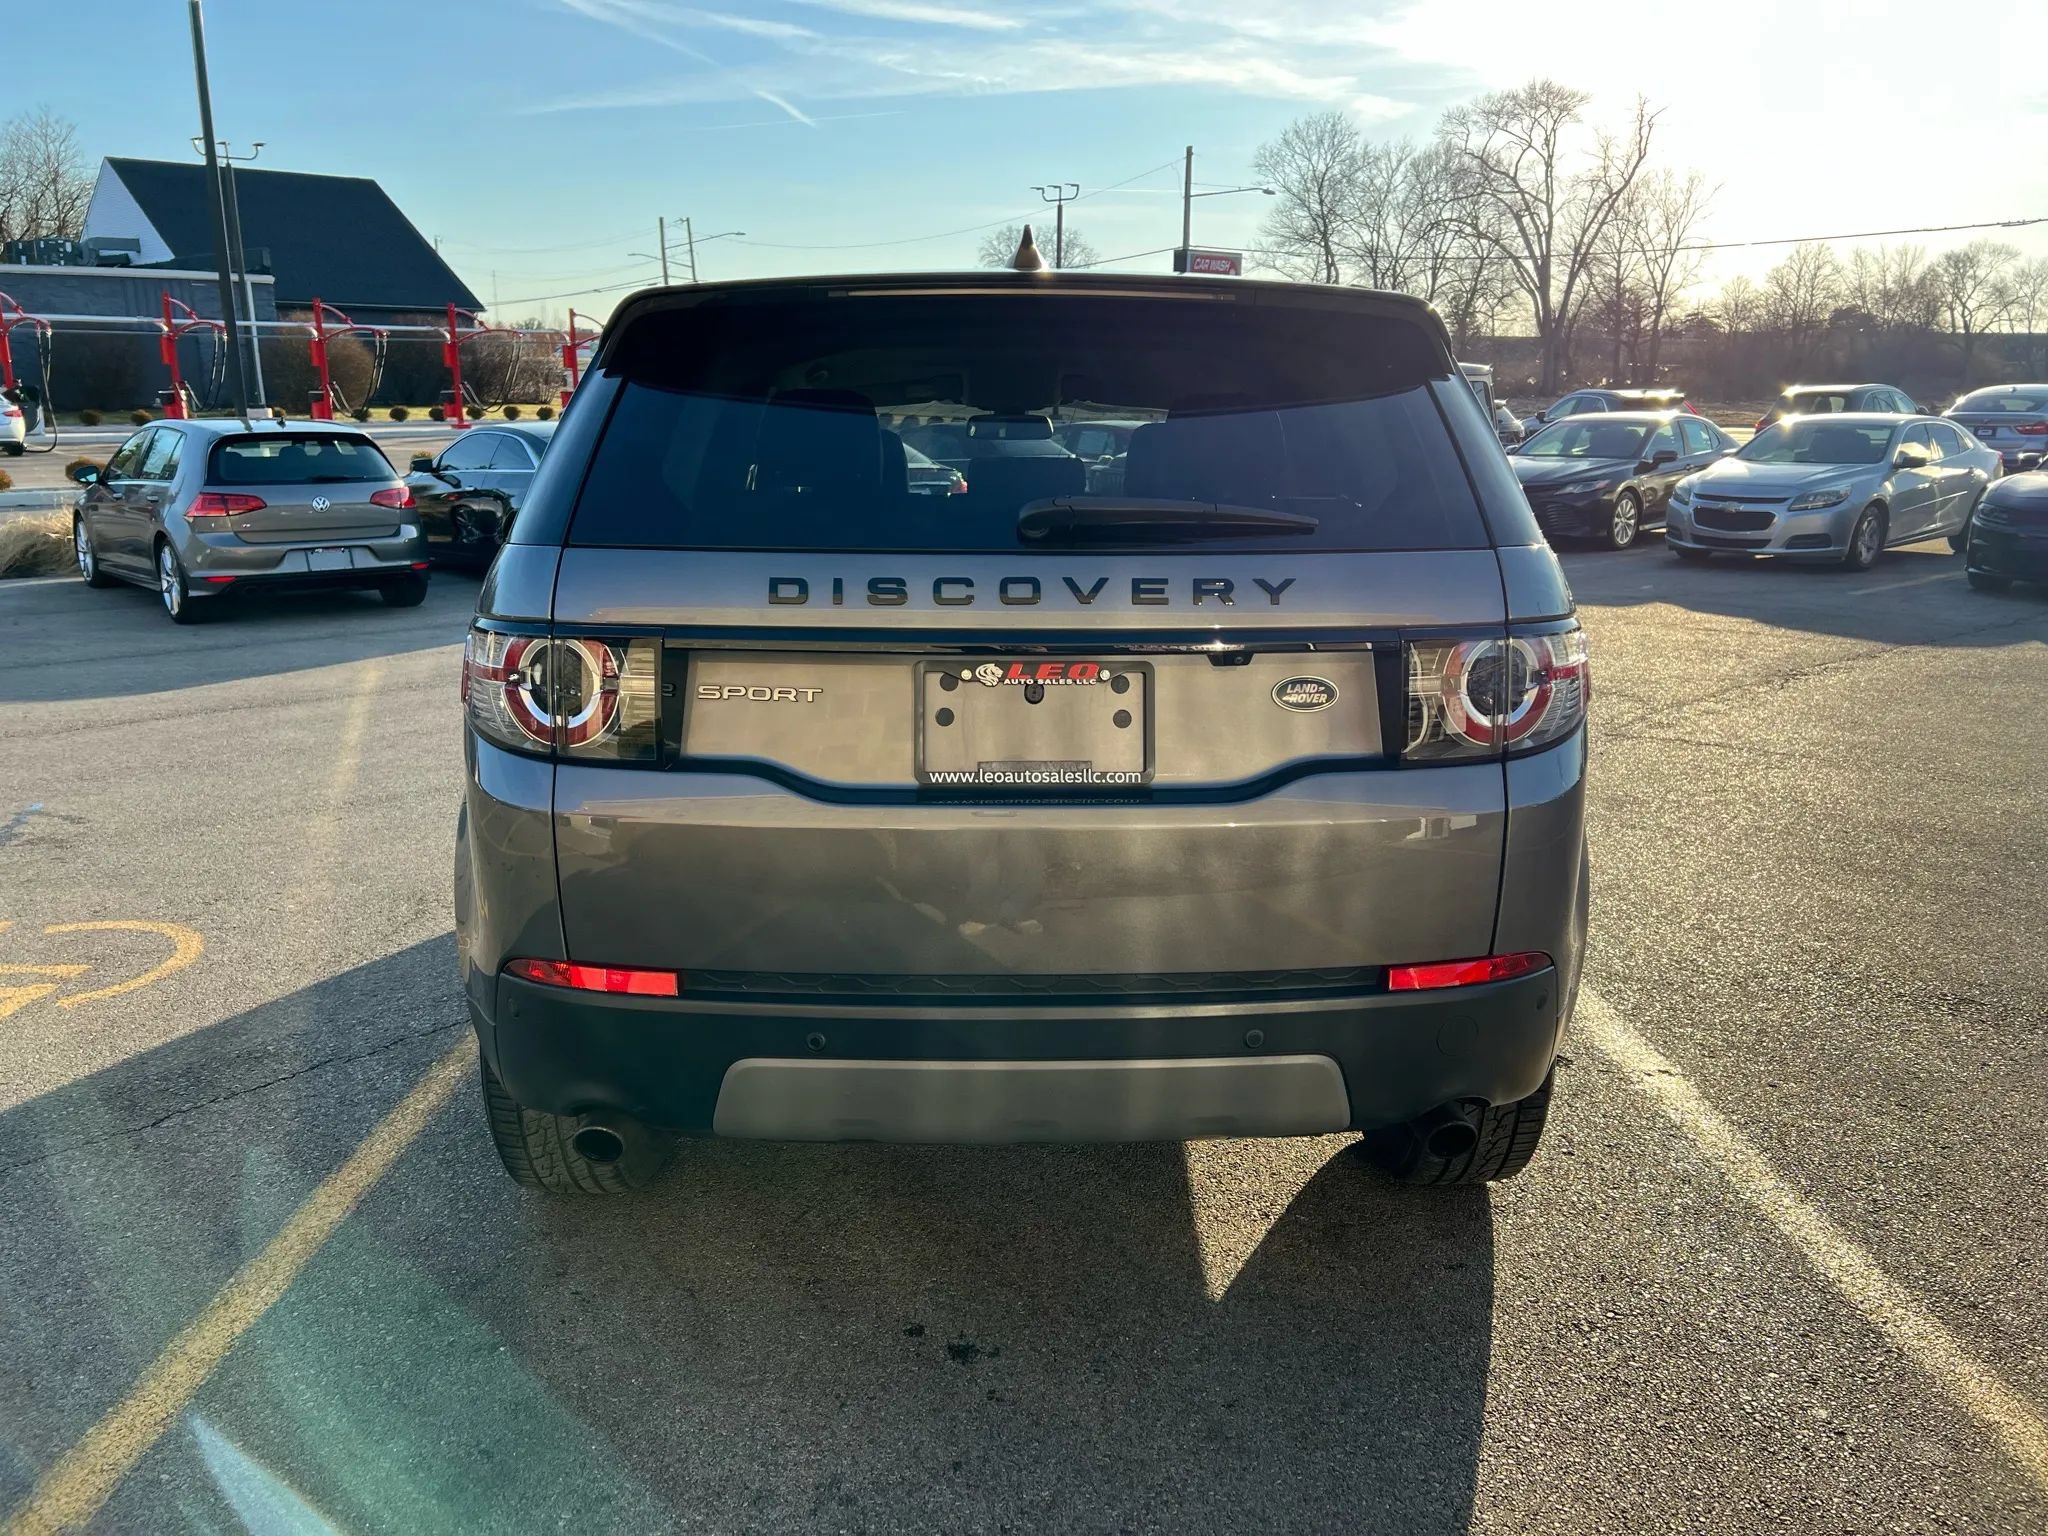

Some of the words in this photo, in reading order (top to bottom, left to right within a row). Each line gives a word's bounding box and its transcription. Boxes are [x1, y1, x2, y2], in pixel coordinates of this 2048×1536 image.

[1194, 258, 1210, 270] CAR
[768, 576, 1297, 606] DISCOVERY
[1007, 663, 1099, 679] LEO
[697, 684, 823, 702] SPORT
[1286, 684, 1318, 693] LAND
[1289, 693, 1327, 703] ROVER
[929, 768, 1142, 784] www.leoautosalesllc.com
